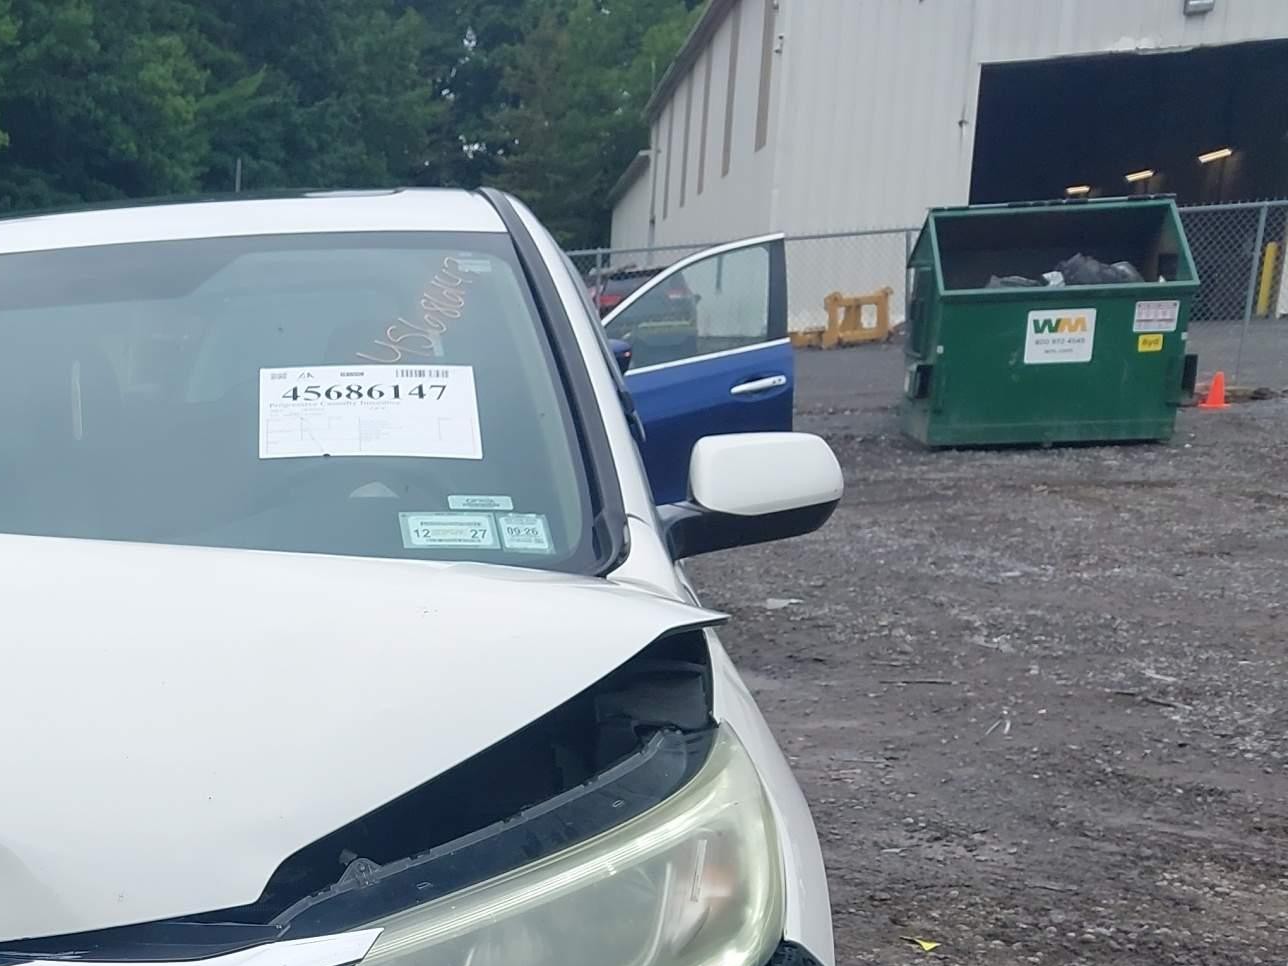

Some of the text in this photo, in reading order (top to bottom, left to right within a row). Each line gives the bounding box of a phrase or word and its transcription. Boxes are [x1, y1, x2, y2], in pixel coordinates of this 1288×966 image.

[1033, 317, 1087, 334] WM
[282, 383, 447, 401] 45686147
[414, 528, 432, 539] 12
[470, 528, 488, 539] 27
